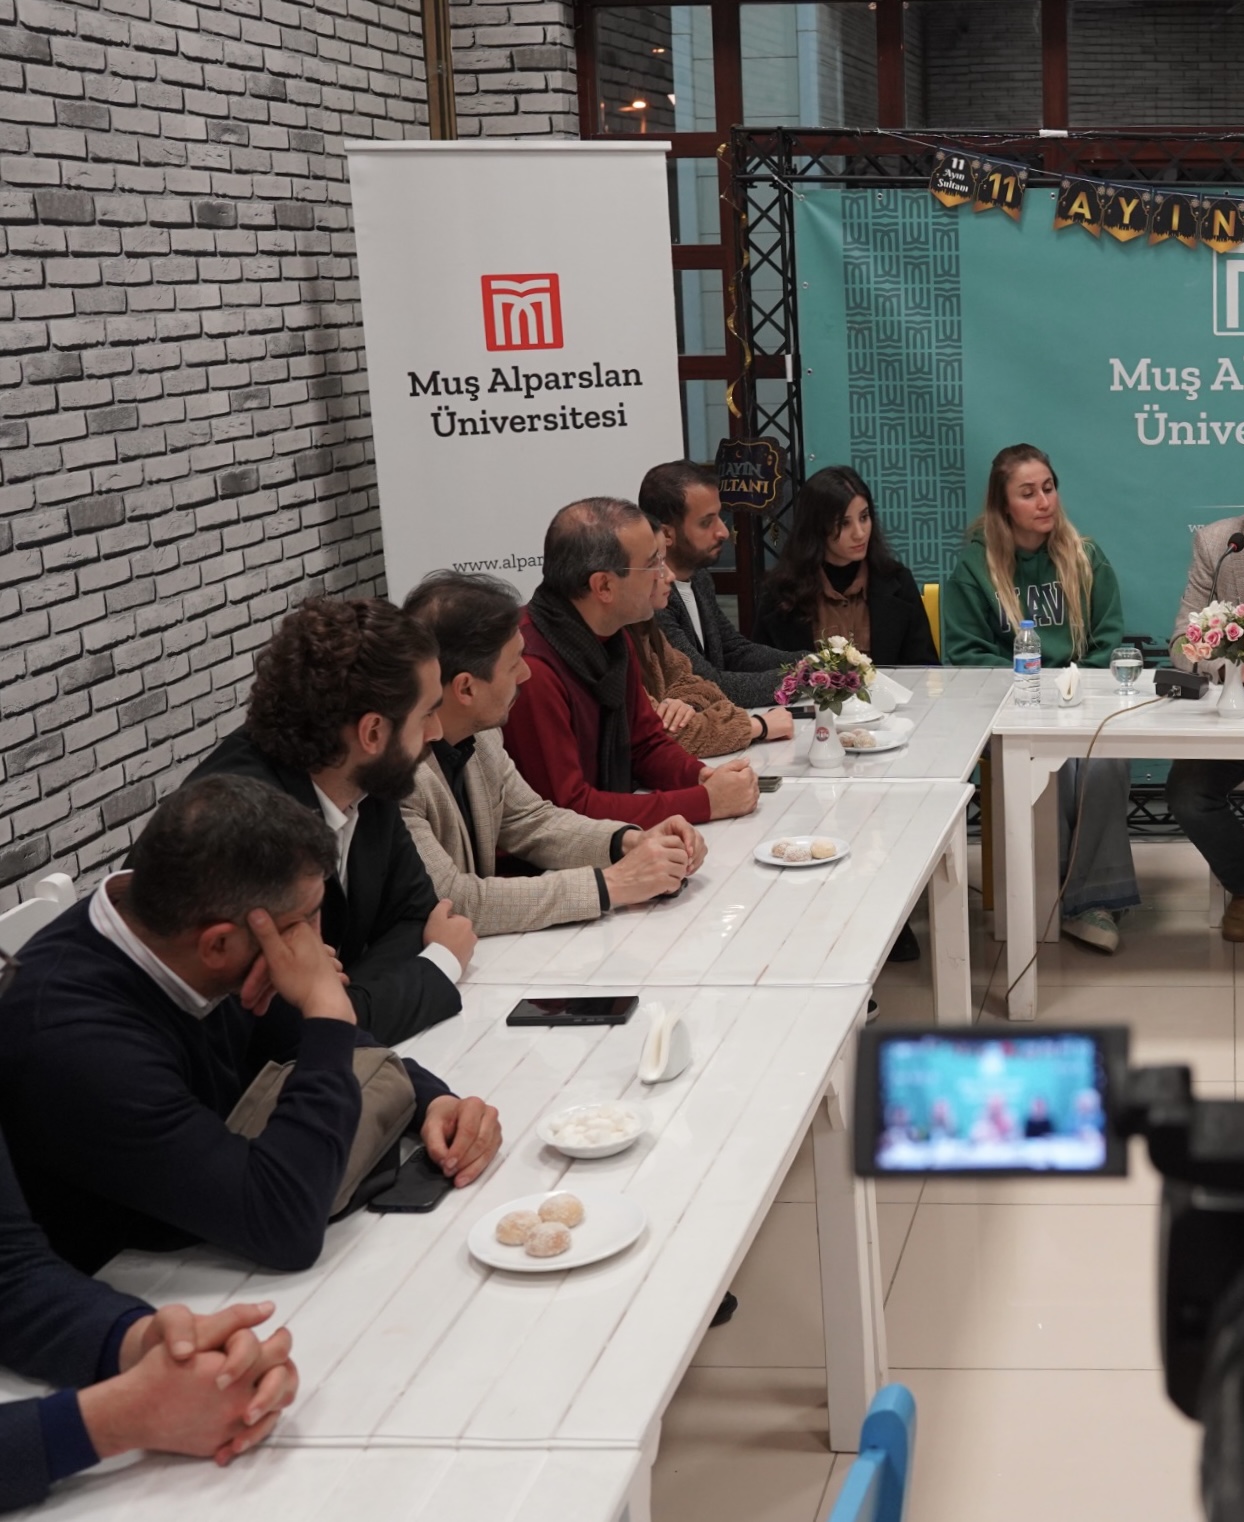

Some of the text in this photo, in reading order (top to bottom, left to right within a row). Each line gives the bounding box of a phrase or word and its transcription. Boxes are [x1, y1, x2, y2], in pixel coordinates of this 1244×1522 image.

[951, 157, 965, 170] 11
[989, 172, 1016, 203] 11
[1067, 191, 1237, 238] AYIN
[407, 361, 644, 402] Muş Alparslan
[1109, 357, 1201, 401] Muş
[430, 402, 629, 438] Üniversitesi
[452, 553, 545, 573] www.alpar
